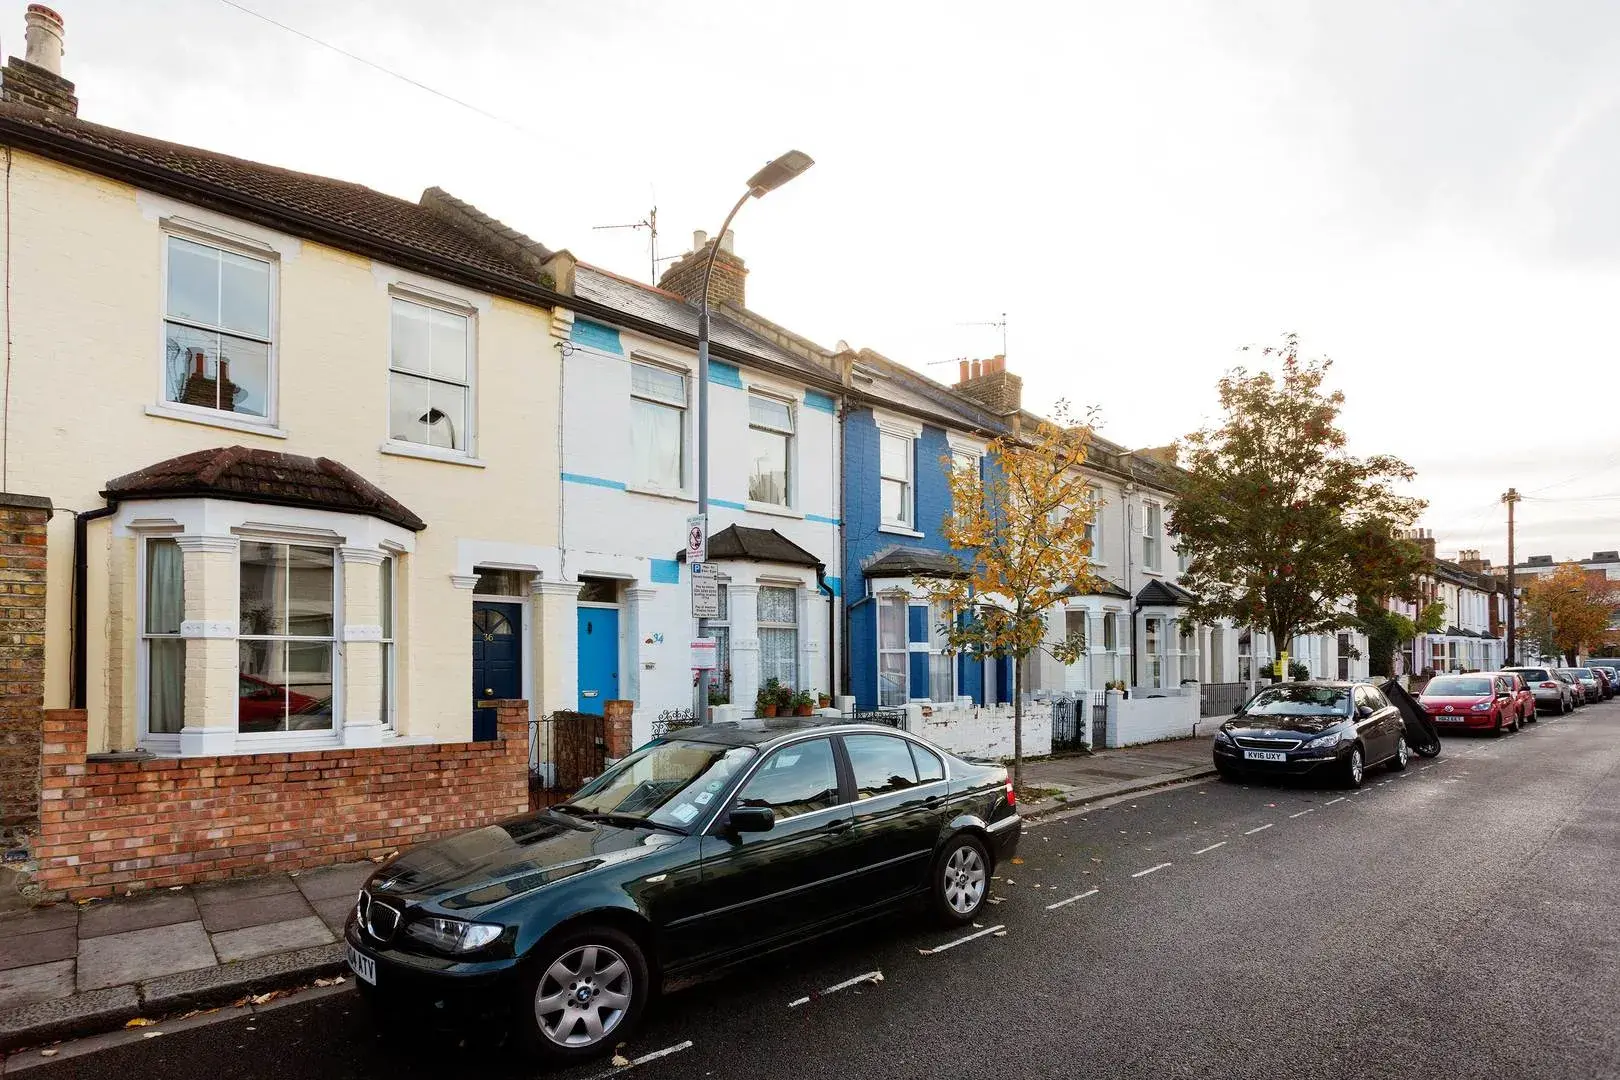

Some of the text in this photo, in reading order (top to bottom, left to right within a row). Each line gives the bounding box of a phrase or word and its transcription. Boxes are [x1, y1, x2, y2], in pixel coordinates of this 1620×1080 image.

[694, 564, 700, 572] P
[482, 633, 494, 642] 36
[1248, 751, 1264, 760] KV16
[358, 954, 374, 979] ATY
